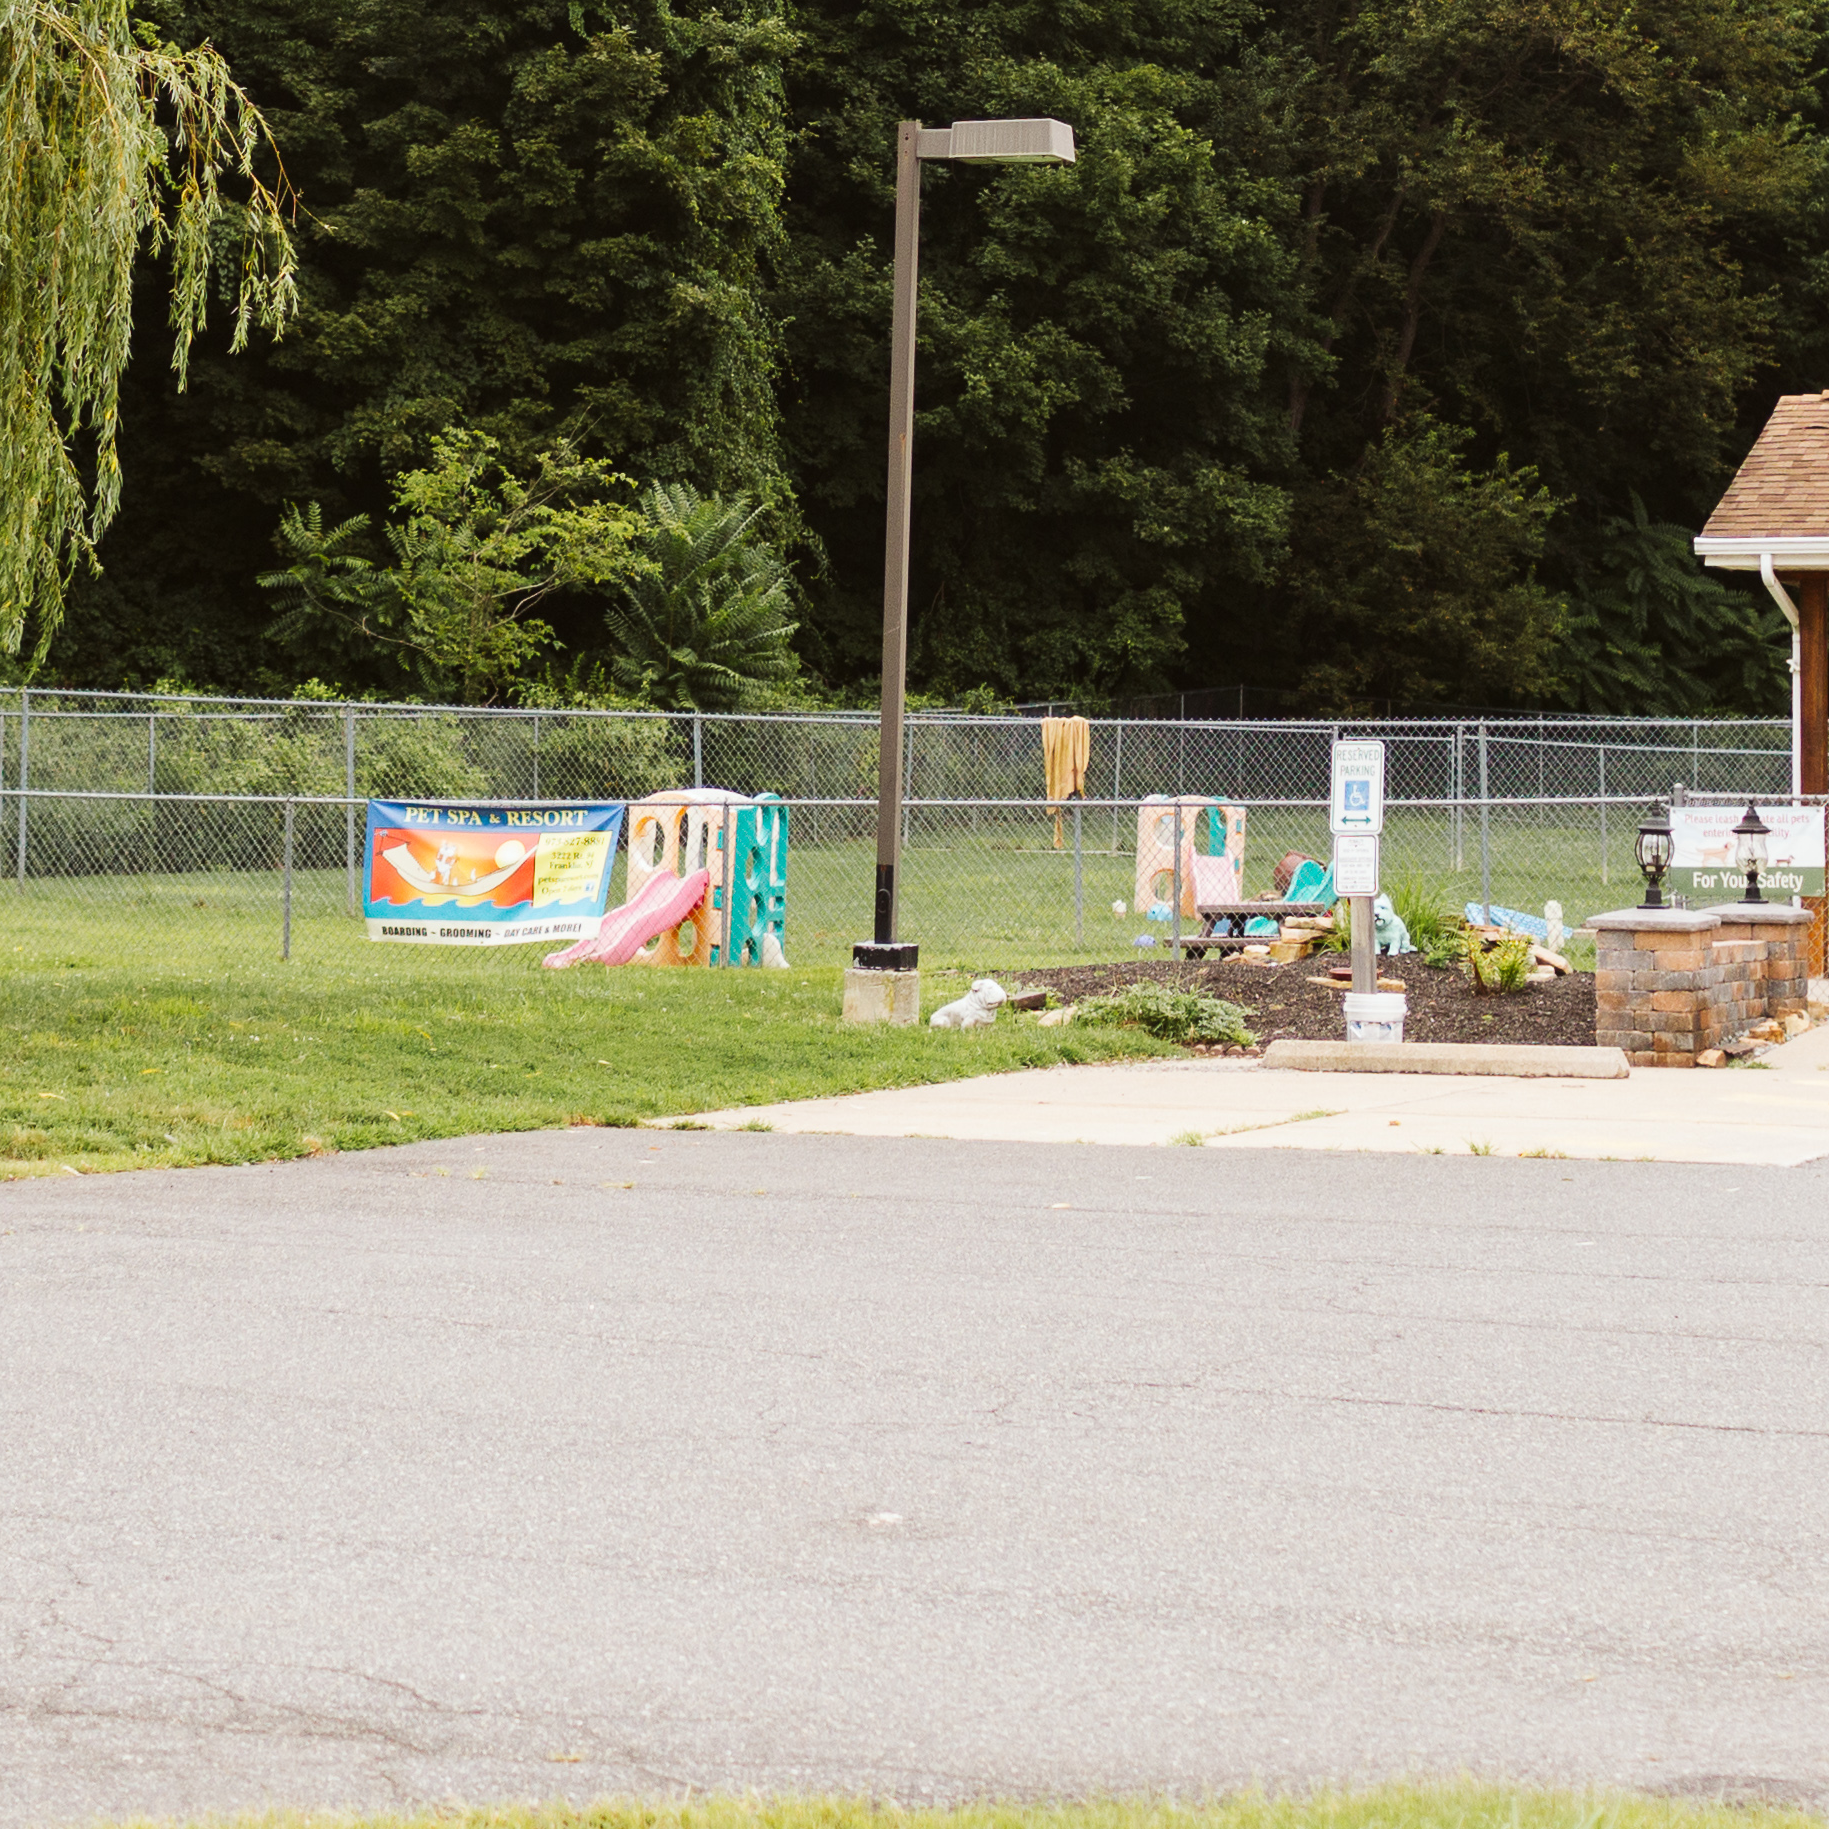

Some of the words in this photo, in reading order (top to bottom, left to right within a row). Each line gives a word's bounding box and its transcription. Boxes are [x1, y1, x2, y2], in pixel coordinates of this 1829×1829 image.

[1337, 749, 1379, 761] RESERVED
[1340, 765, 1375, 776] PARKING
[404, 806, 443, 824] PET
[447, 809, 482, 826] SPA
[489, 813, 500, 824] &
[506, 809, 588, 827] RESORT
[1684, 813, 1713, 824] Please
[1715, 814, 1739, 824] leash
[1777, 814, 1789, 823] all
[1791, 814, 1810, 825] pets
[1692, 871, 1718, 889] For
[1719, 871, 1749, 889] You
[1758, 871, 1803, 893] Safety
[382, 926, 428, 937] BOARDING
[440, 928, 492, 939] GROOMING
[504, 928, 520, 938] DAY
[522, 925, 543, 936] CARE
[553, 923, 582, 933] MORE!
